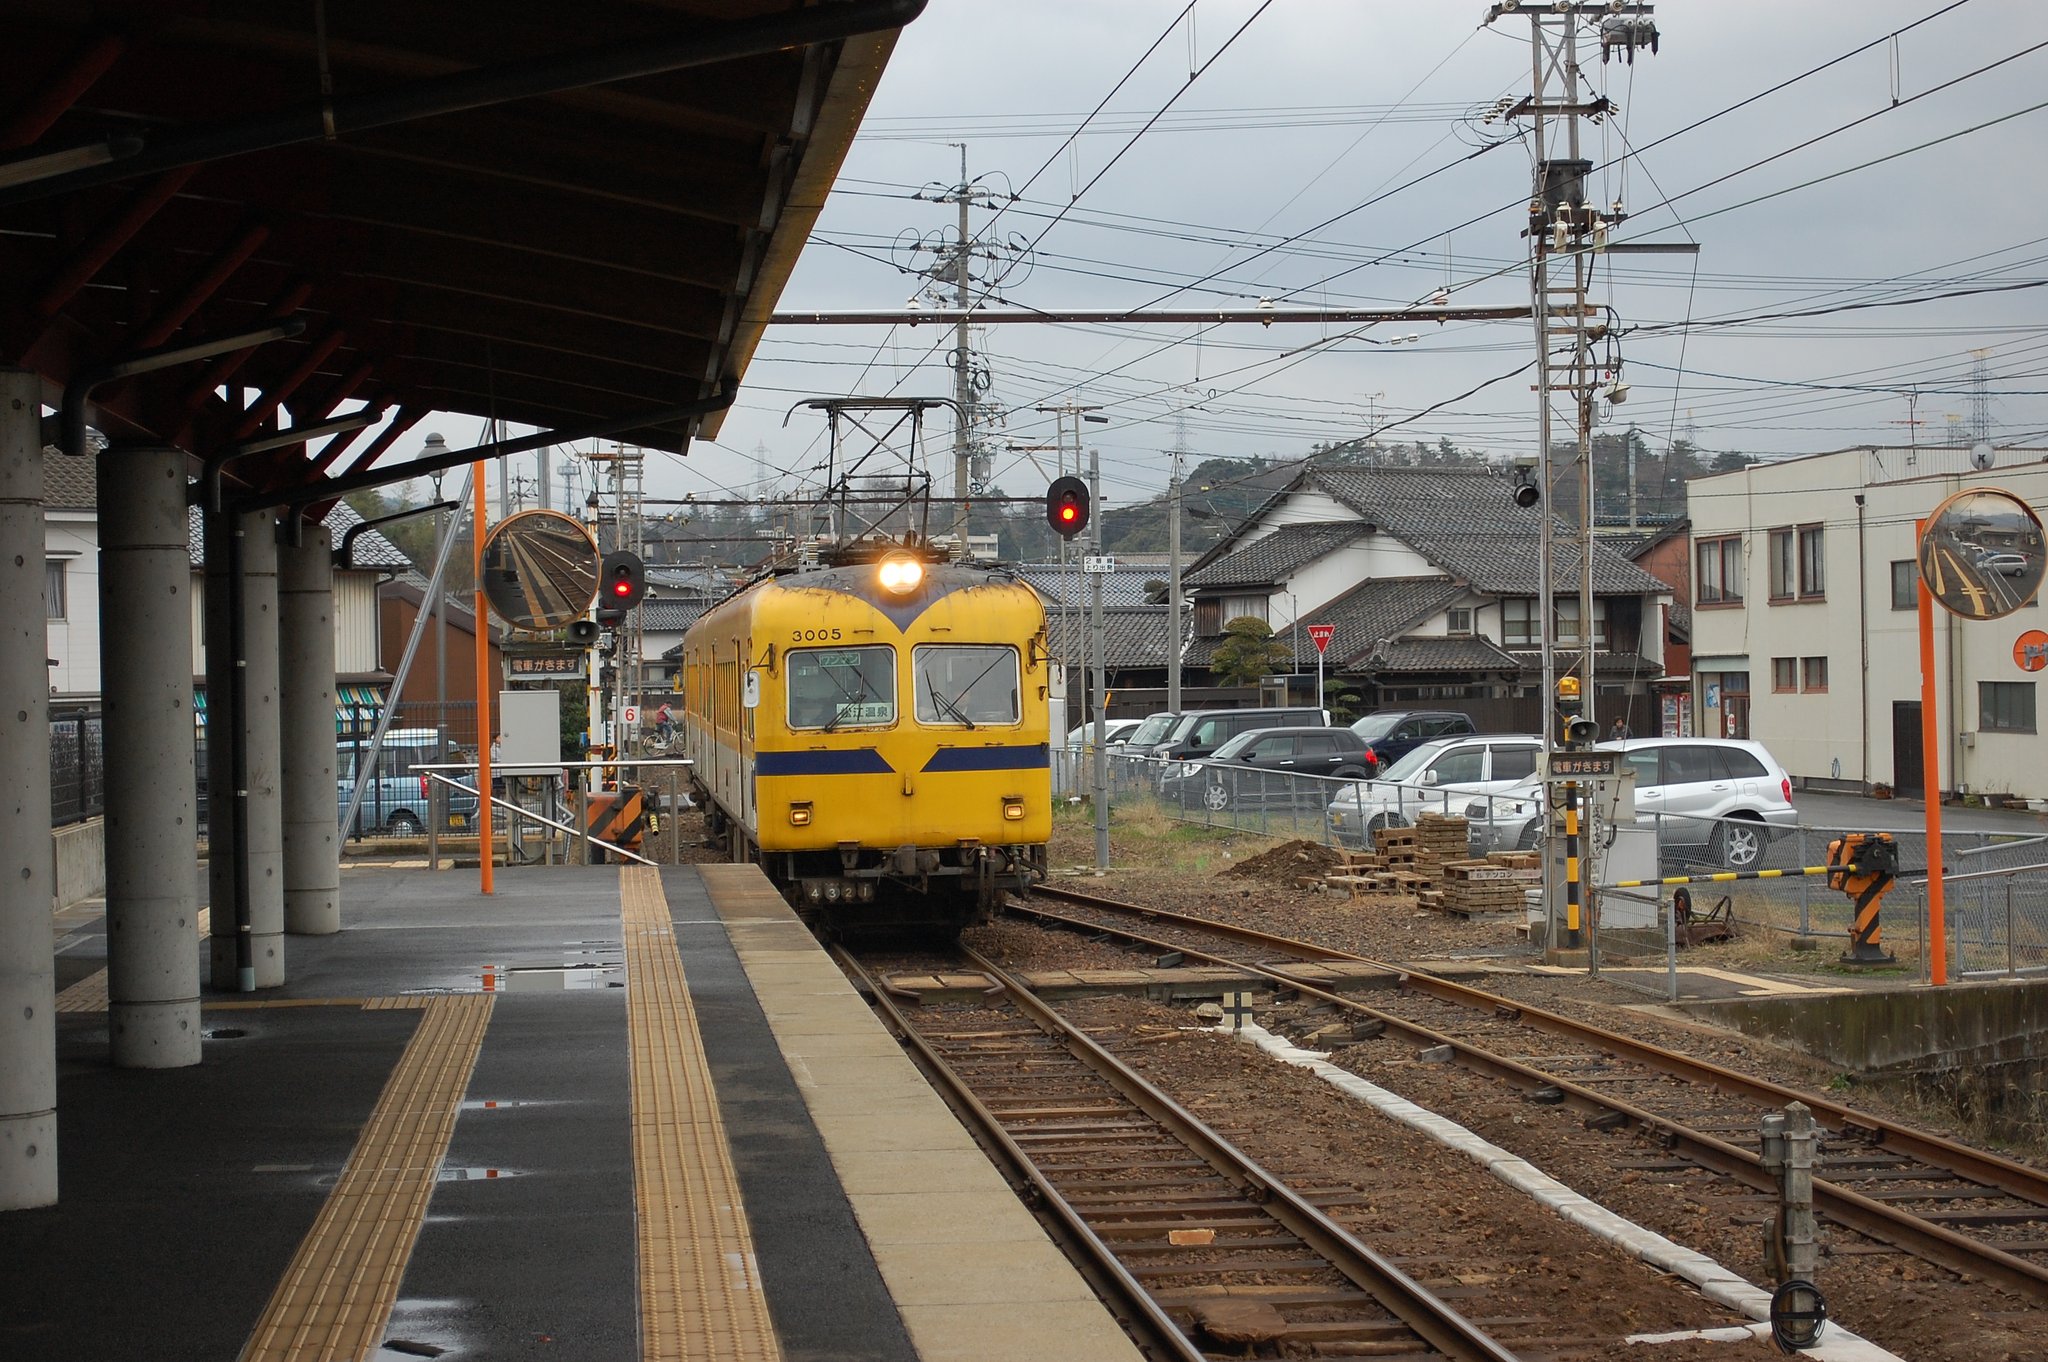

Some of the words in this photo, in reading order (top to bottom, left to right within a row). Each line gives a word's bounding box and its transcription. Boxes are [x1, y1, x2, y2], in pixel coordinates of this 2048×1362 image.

[792, 629, 841, 641] 3005
[512, 659, 576, 672] 電車がきます
[625, 708, 635, 722] 6
[1552, 761, 1612, 773] 電車がきます
[811, 888, 820, 898] 4
[828, 888, 837, 898] 3
[845, 887, 852, 898] 2
